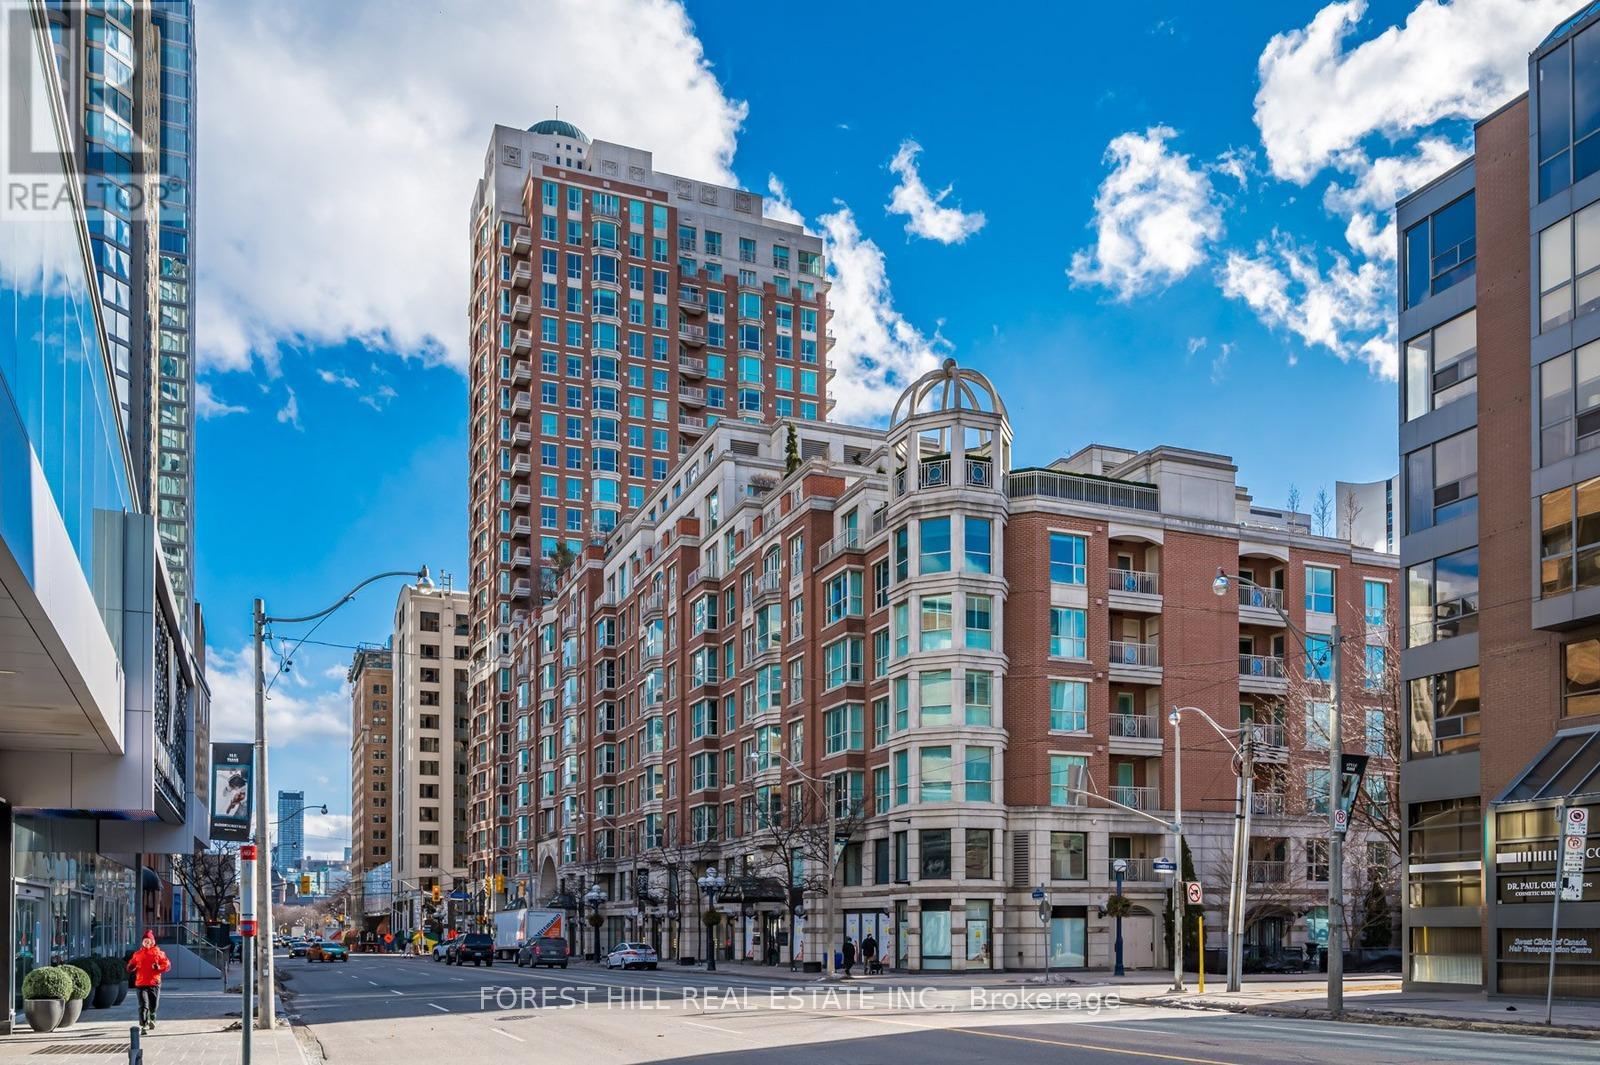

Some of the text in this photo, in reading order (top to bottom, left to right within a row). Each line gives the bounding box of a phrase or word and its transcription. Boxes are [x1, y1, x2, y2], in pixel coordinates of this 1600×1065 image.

[1507, 882, 1520, 891] DR.
[1521, 882, 1540, 890] PAUL
[1556, 938, 1563, 946] of
[1564, 938, 1587, 946] Canada
[1523, 945, 1570, 955] Transplanation
